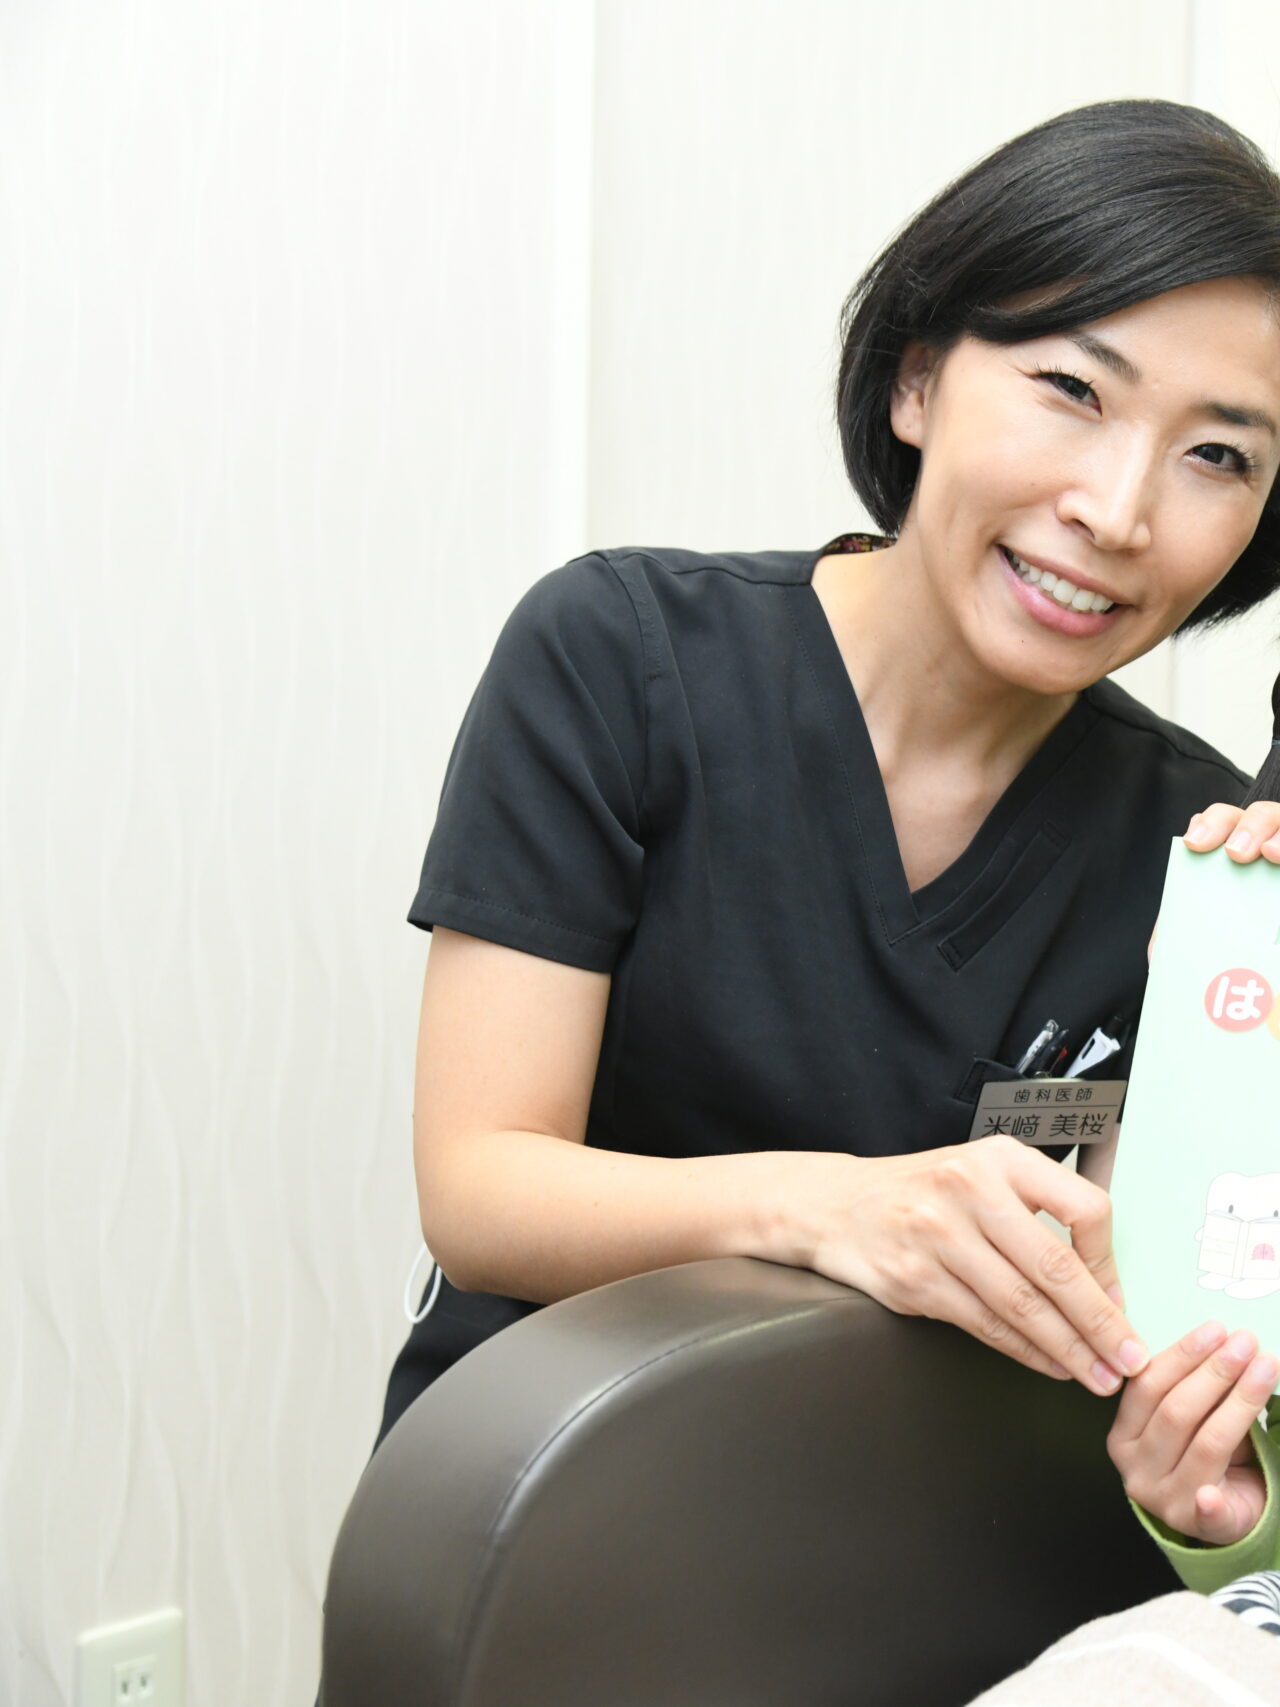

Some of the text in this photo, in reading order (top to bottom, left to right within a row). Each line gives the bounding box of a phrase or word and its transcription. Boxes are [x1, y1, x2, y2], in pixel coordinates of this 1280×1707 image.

[1014, 1088, 1093, 1103] 歯科医師
[1049, 1113, 1108, 1137] 美桜
